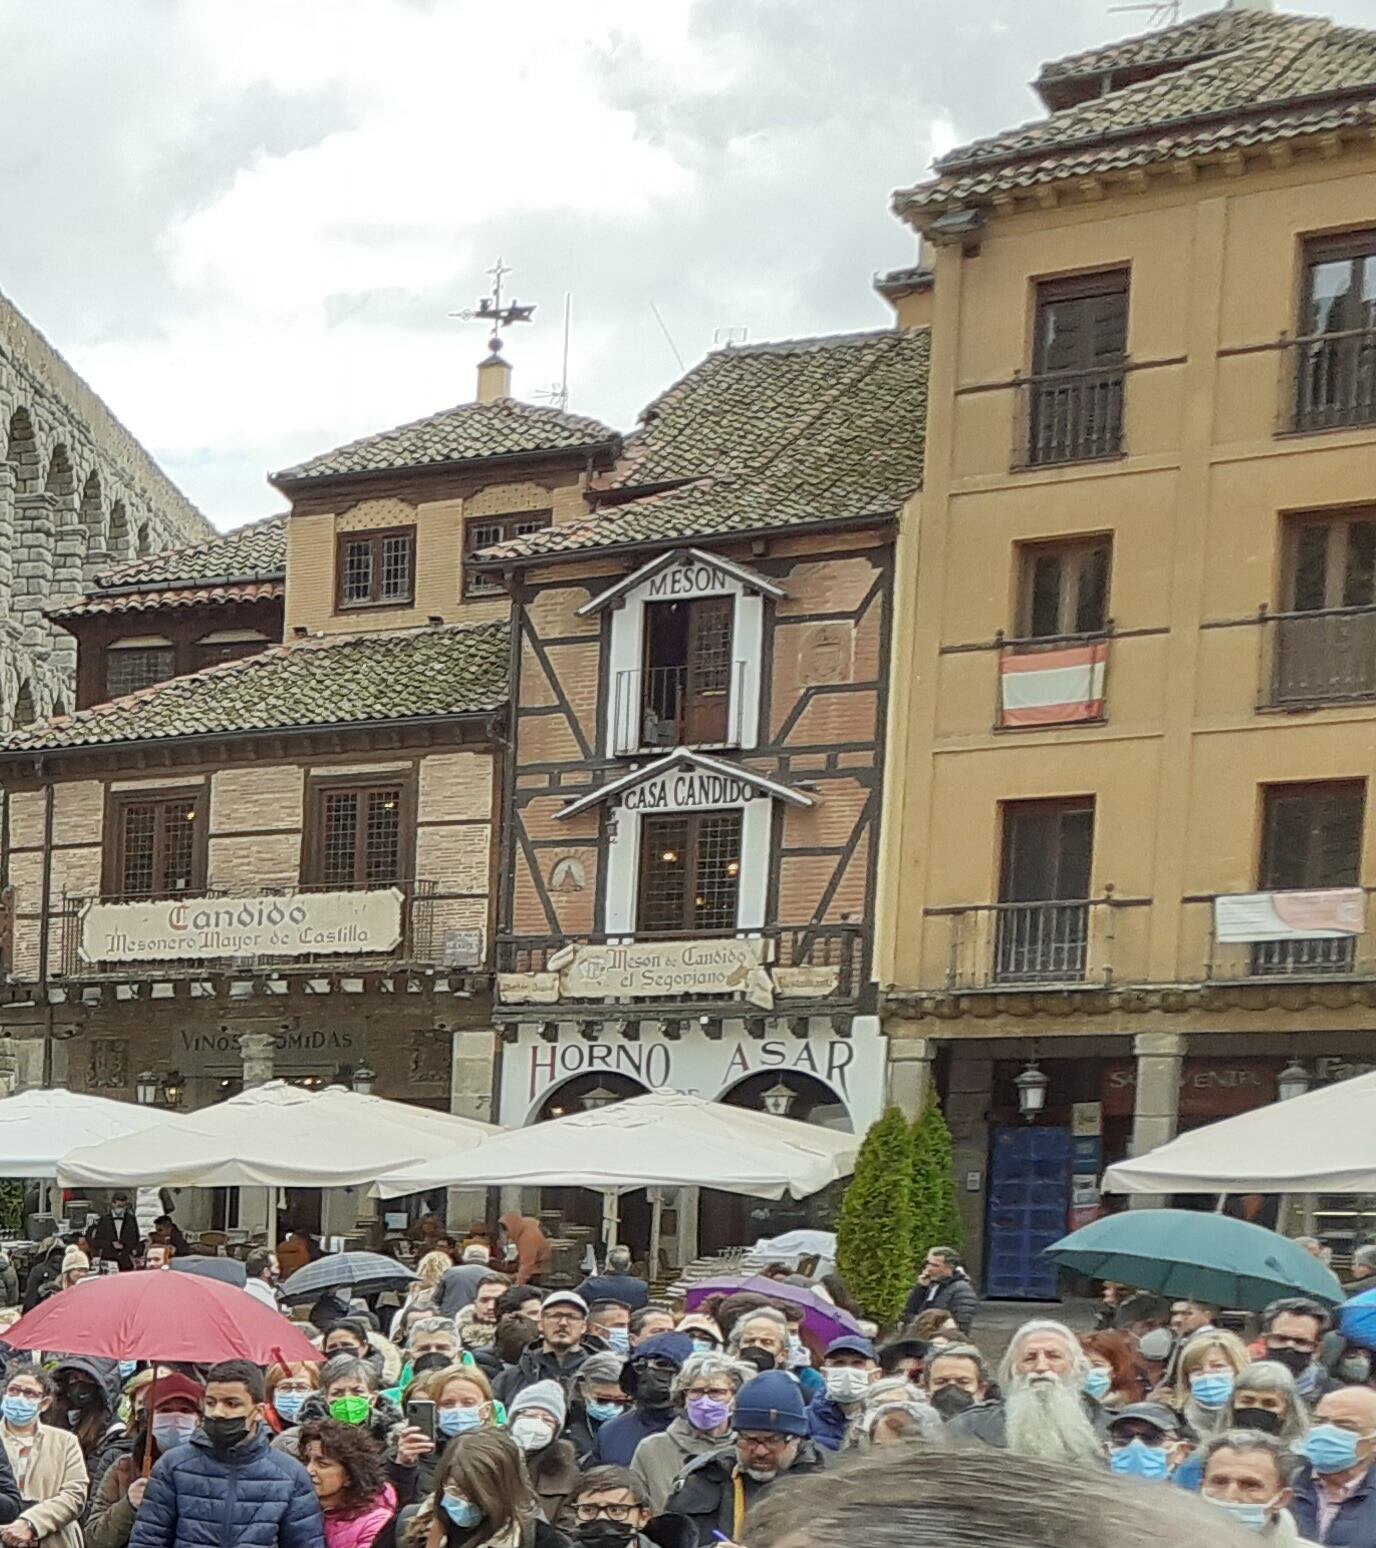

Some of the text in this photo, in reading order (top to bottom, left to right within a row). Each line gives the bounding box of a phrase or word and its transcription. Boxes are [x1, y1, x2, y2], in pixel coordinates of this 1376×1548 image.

[649, 567, 726, 597] MESON
[624, 775, 754, 811] CASA CANDIDO
[168, 901, 306, 931] Candido
[105, 925, 369, 954] Mesonero Mayor de Castilla
[606, 948, 661, 972] Meson
[681, 946, 746, 967] Candido
[181, 1029, 353, 1051] VINOS OMIDAS
[530, 1040, 854, 1104] HORNO ASAR
